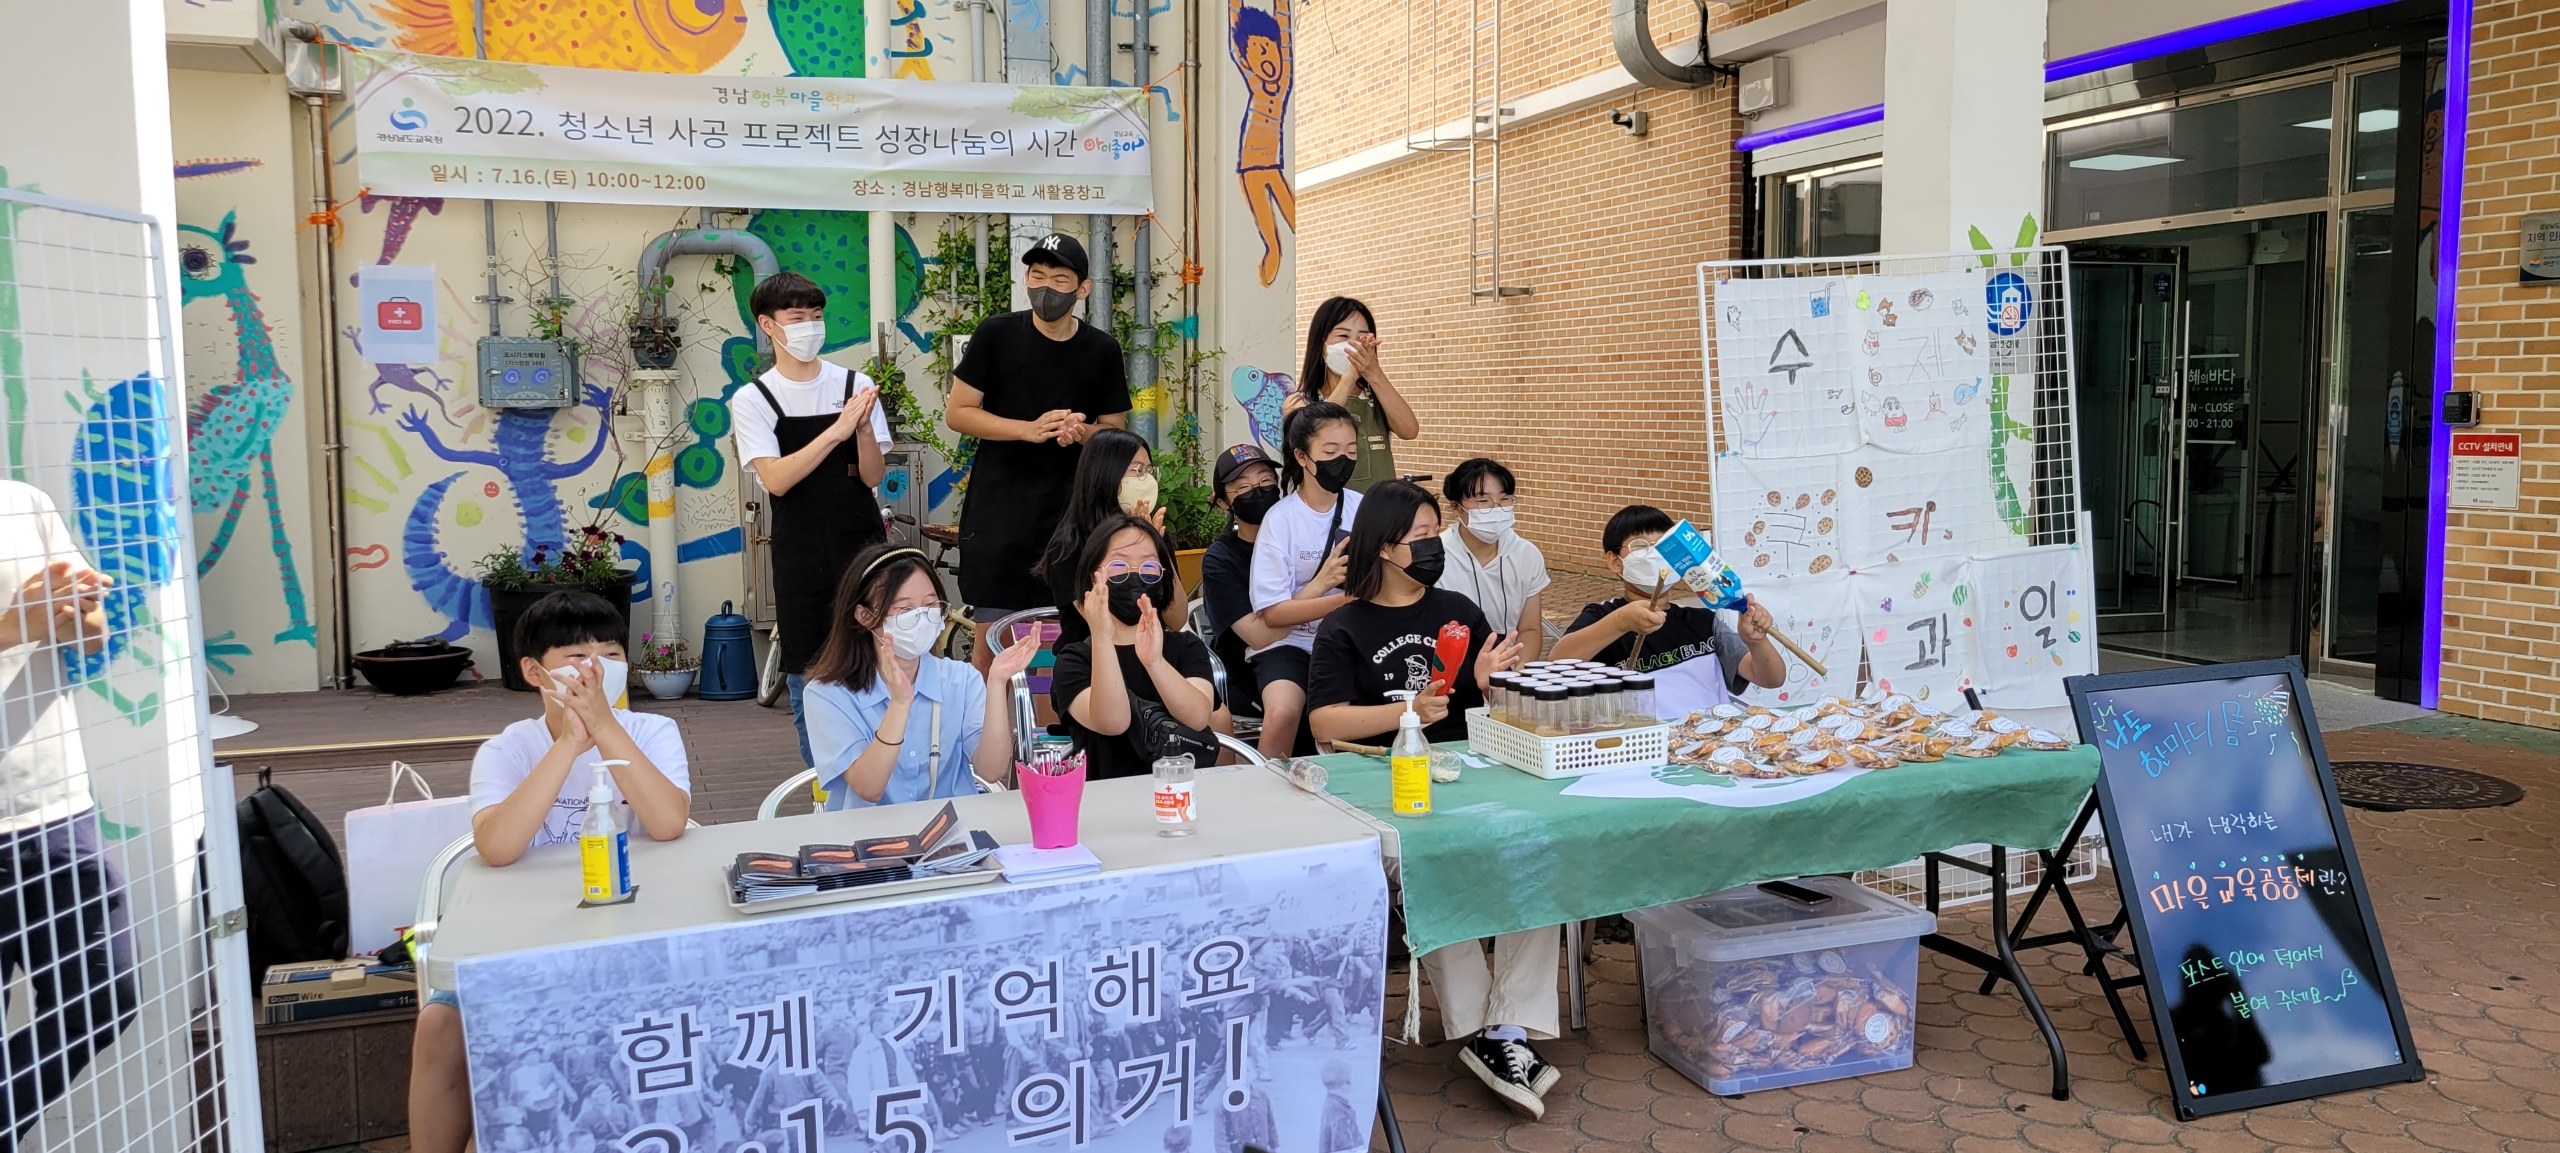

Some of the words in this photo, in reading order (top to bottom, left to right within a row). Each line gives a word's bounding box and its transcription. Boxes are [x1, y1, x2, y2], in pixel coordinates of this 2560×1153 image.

[712, 86, 858, 112] 경남행복마을학교
[376, 132, 443, 145] 경상남도교육청
[454, 105, 545, 138] 2022.
[558, 111, 654, 146] 청소년
[668, 115, 730, 149] 사공
[742, 122, 864, 154] 프로젝트
[875, 123, 1016, 157] 성장나눔의
[1027, 128, 1078, 159] 시간
[430, 164, 468, 184] 일시
[491, 167, 578, 189] 7.16.(토)
[586, 171, 707, 191] 10:00~12:00
[852, 179, 885, 197] 장소
[902, 181, 1027, 200] 경남행복마을학교
[1031, 182, 1106, 201] 새활용창고
[2527, 232, 2546, 243] 지역
[2188, 368, 2236, 386] 혜의바다
[2205, 402, 2235, 413] CLOSE
[2187, 418, 2199, 428] 00
[2206, 418, 2234, 429] 21:00
[2458, 442, 2481, 451] CCTV
[2482, 442, 2513, 452] 설치안내
[1372, 634, 1422, 664] COLLEGE
[1634, 648, 1680, 671] LACK
[1384, 672, 1394, 681] 19
[2151, 821, 2194, 842] 내가
[2208, 811, 2278, 836] 생각하는
[270, 994, 299, 1004] Double
[301, 991, 325, 1001] Wire
[617, 993, 813, 1094] 함께
[890, 938, 1254, 1053] 기억해요
[1011, 1020, 1249, 1143] 의거!
